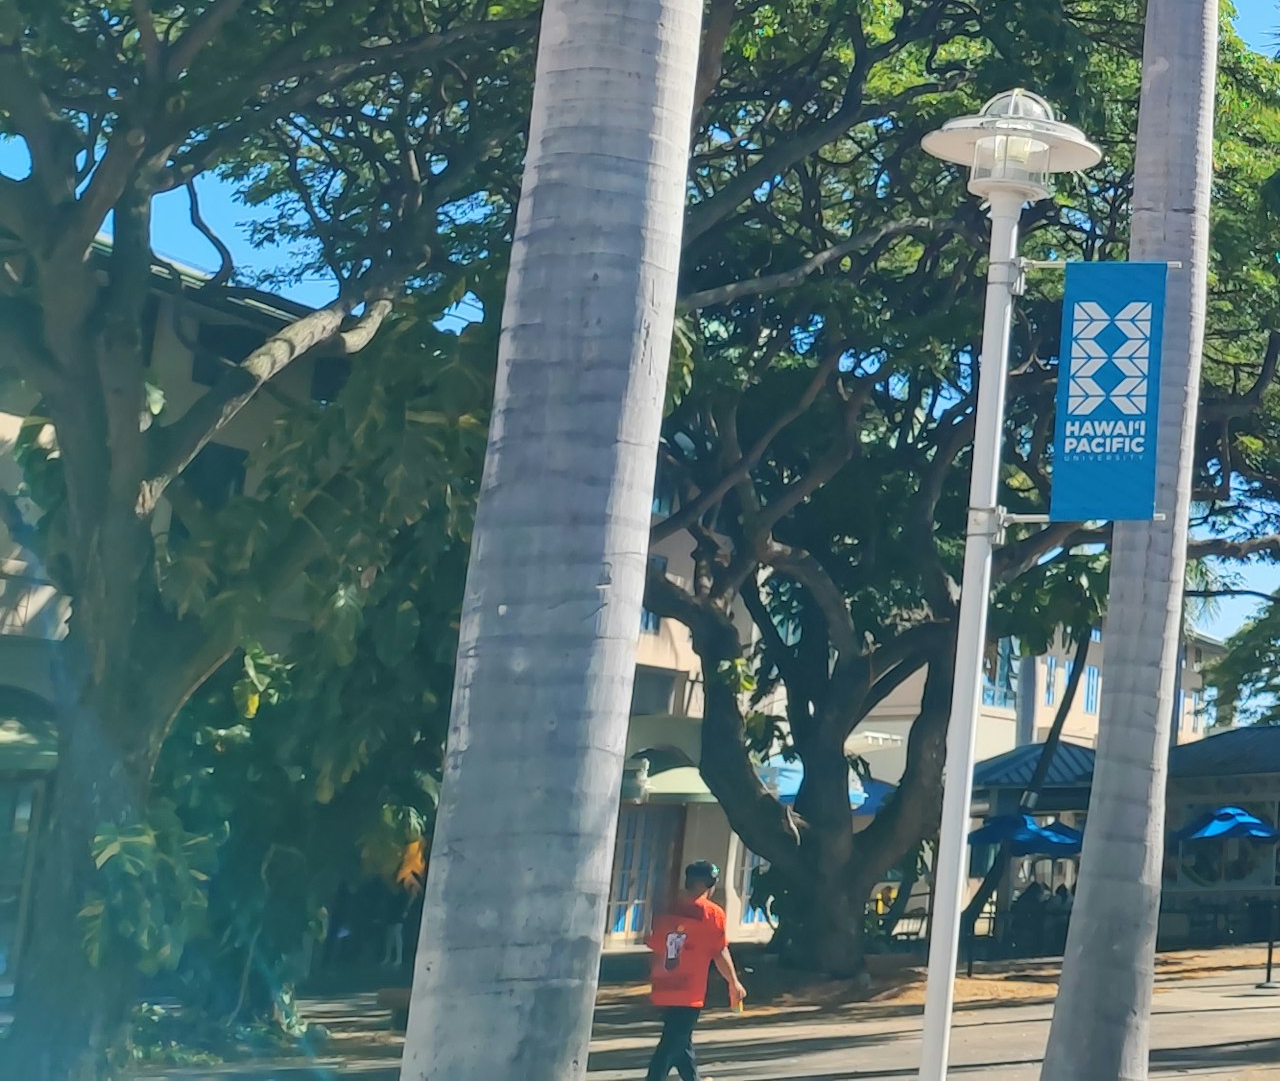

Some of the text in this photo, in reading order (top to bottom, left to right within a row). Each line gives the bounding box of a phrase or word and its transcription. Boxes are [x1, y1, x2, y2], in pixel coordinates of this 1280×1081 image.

[1065, 420, 1146, 437] HAWAI‘I
[1064, 437, 1145, 454] PACIFIC
[1063, 454, 1145, 462] UNIVERSITY
